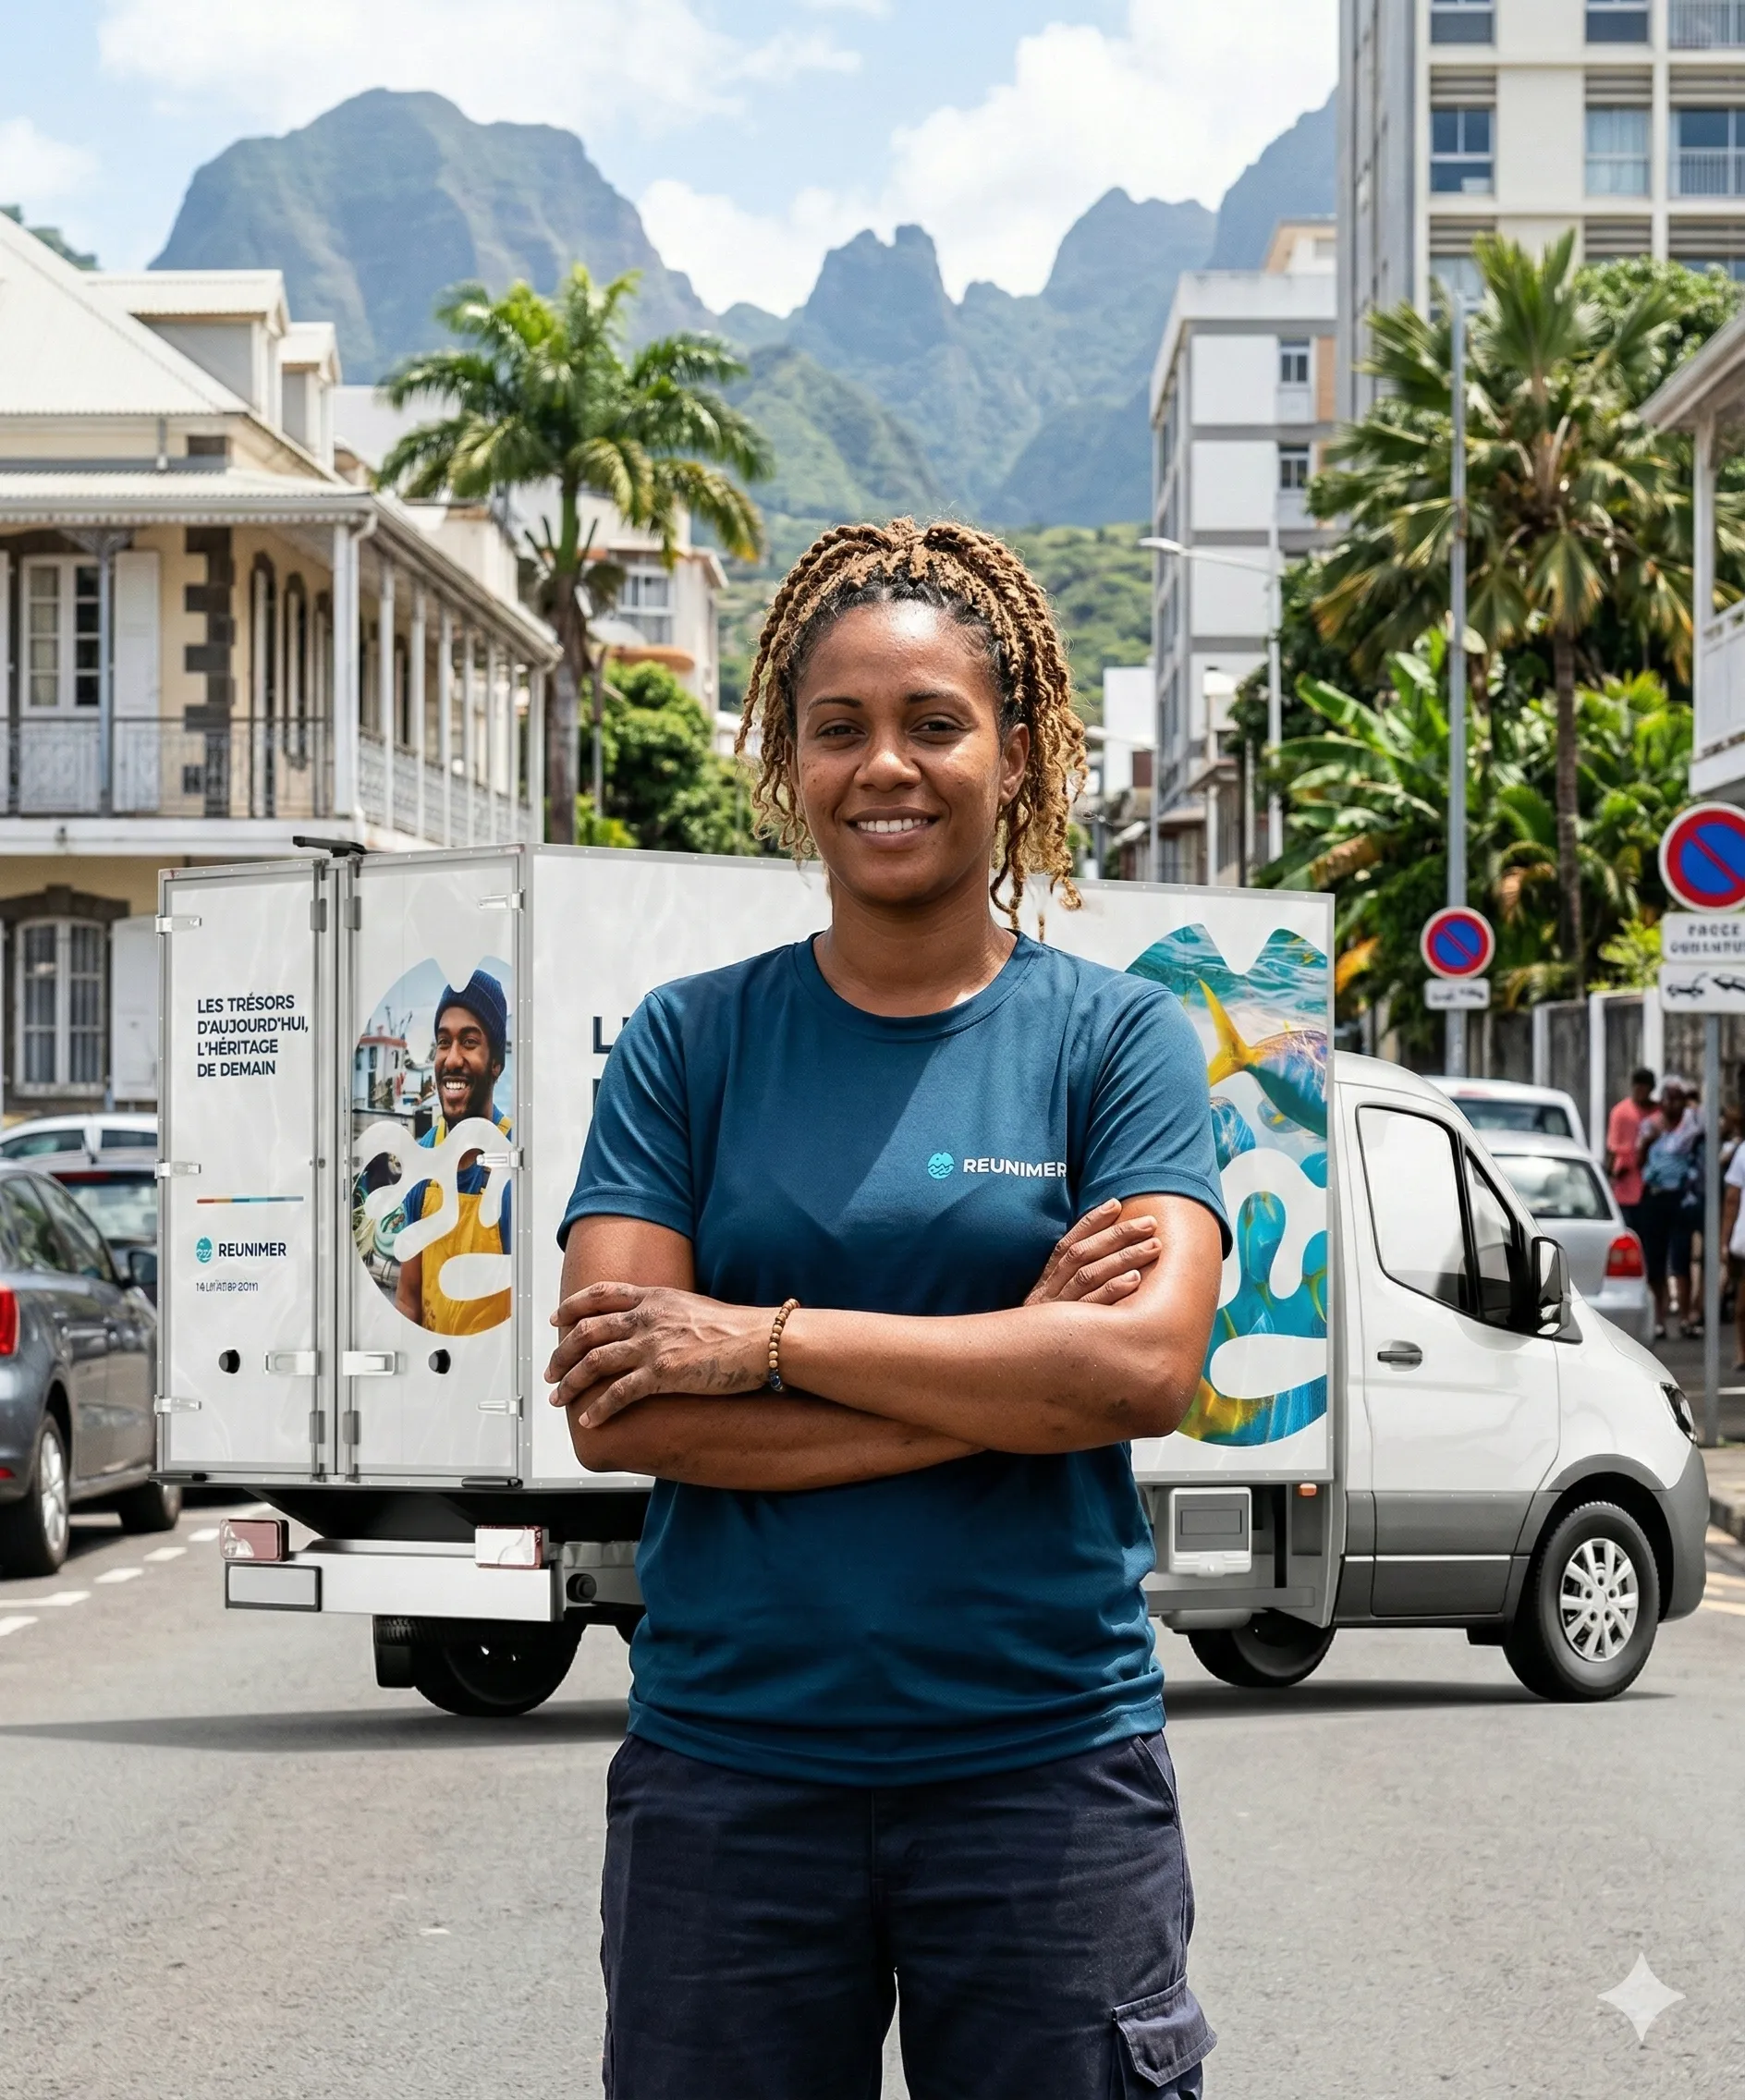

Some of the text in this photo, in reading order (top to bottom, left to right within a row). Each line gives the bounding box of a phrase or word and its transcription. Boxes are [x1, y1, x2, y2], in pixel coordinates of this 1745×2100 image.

[197, 992, 295, 1014] LES TRÉSORS
[197, 1016, 309, 1034] D'AUJOURD'HUI,
[197, 1036, 278, 1056] L'HÉRITAGE
[197, 1060, 275, 1077] DE DEMAIN
[963, 1157, 1067, 1178] REUNIMER
[218, 1242, 287, 1257] REUNIMER
